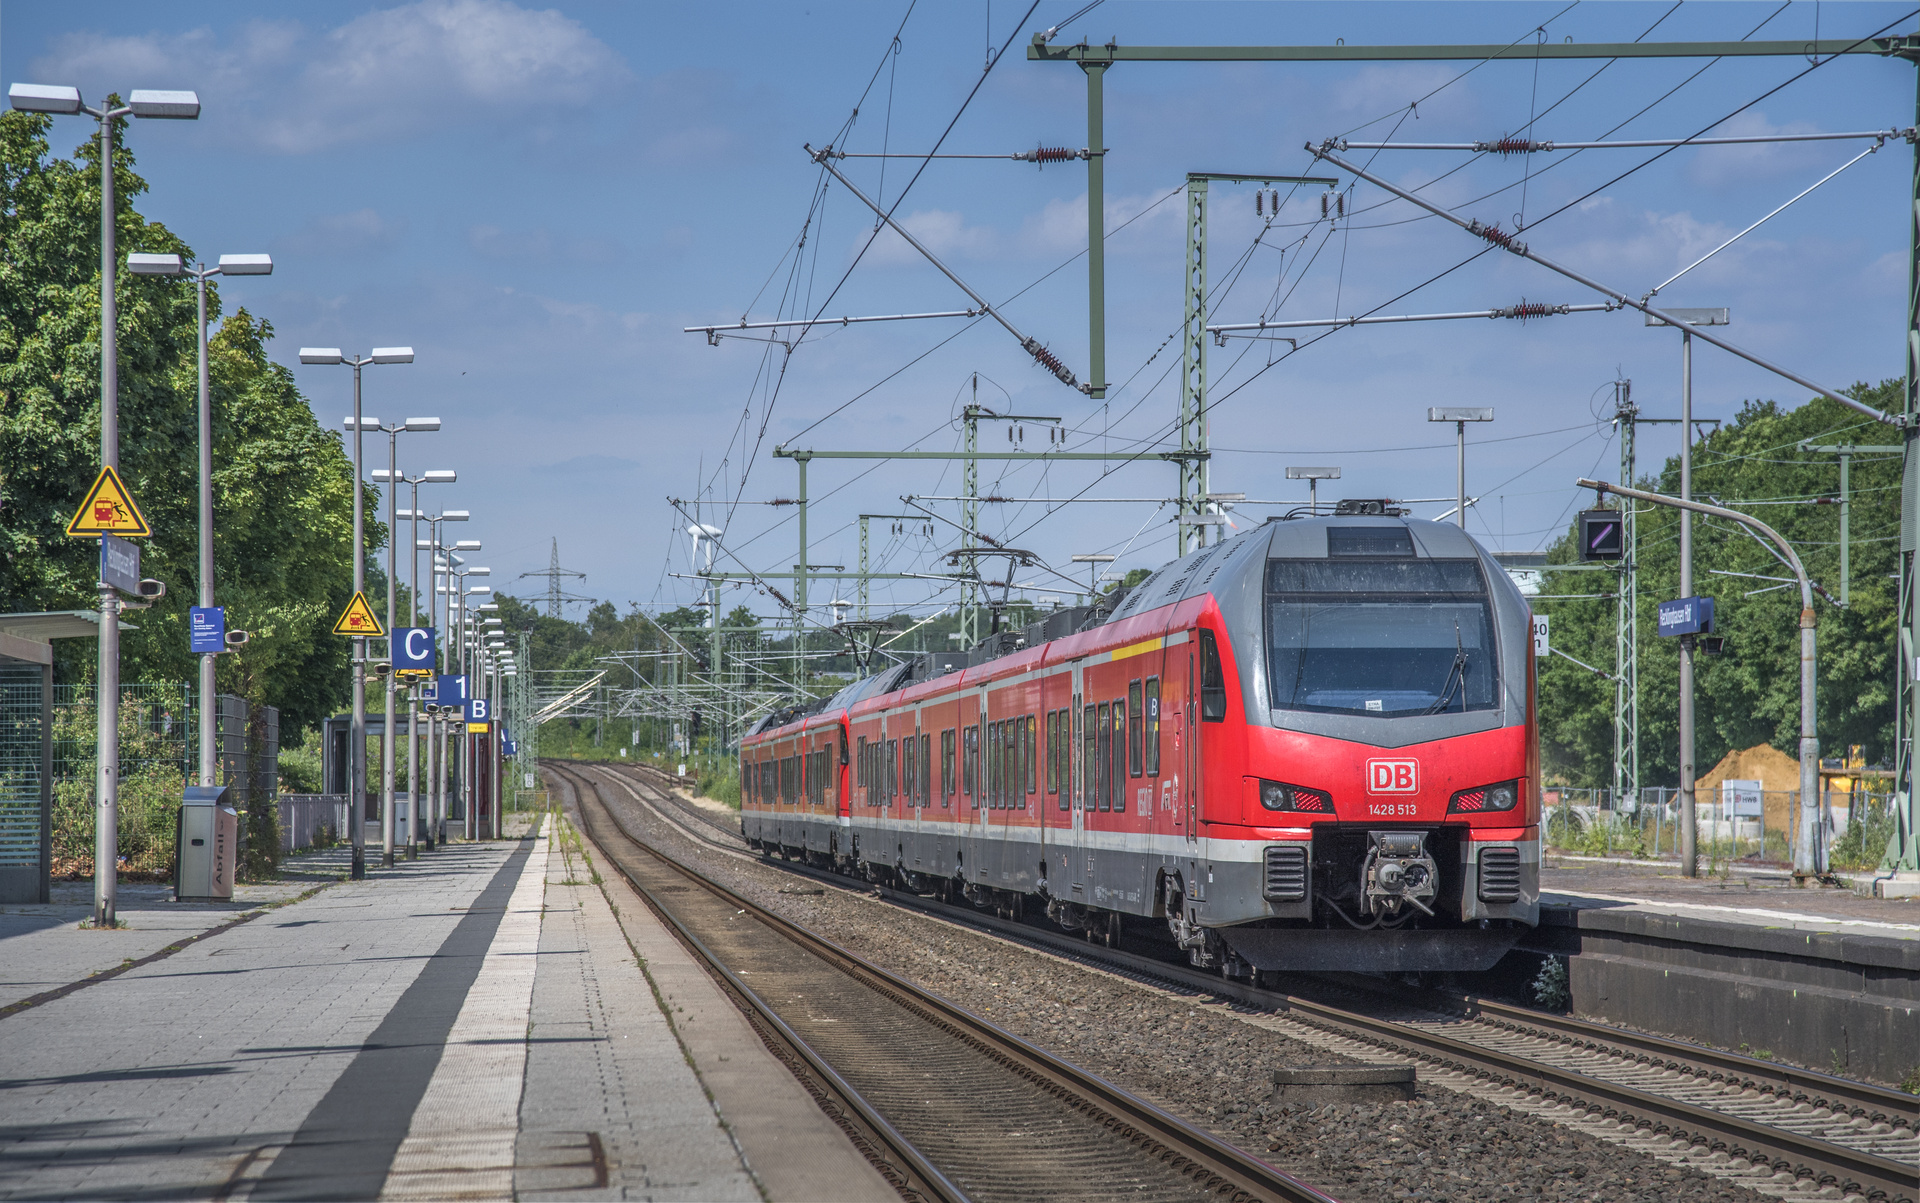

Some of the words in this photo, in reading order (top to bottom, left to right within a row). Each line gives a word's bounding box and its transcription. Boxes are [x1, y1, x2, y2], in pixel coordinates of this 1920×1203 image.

[405, 628, 429, 661] C
[455, 675, 466, 699] 1
[472, 700, 486, 718] B
[1373, 764, 1413, 789] DB
[1368, 804, 1395, 815] 1428
[1397, 804, 1417, 815] 513
[215, 833, 224, 885] Abfall
